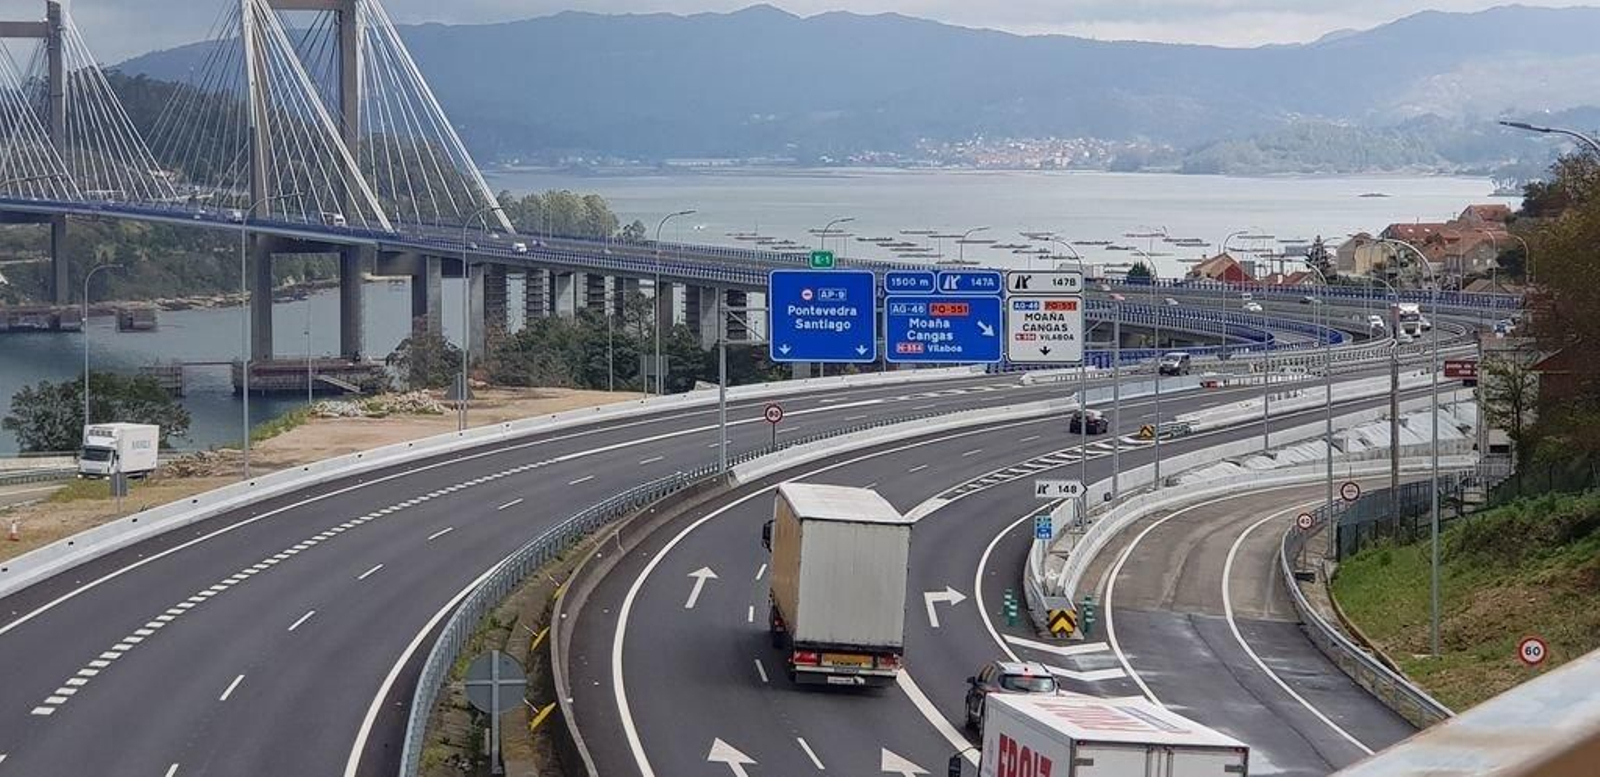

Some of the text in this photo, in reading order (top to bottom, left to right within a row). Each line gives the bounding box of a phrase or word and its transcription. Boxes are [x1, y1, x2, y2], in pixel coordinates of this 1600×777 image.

[814, 255, 831, 264] E-1
[891, 278, 917, 286] 1500
[971, 278, 994, 286] 147A
[1052, 278, 1076, 286] 147B
[821, 290, 845, 298] AP-9
[788, 305, 857, 316] Pontevedra
[892, 304, 968, 313] AG-46 PO-551
[1025, 312, 1065, 321] MOAÑA
[795, 319, 851, 331] Santiago
[909, 318, 951, 328] Moaña
[1022, 323, 1068, 331] CANGAS
[907, 330, 953, 342] Cangas
[927, 344, 962, 352] Vilaboa
[1058, 484, 1077, 494] 148
[1525, 646, 1541, 656] 60
